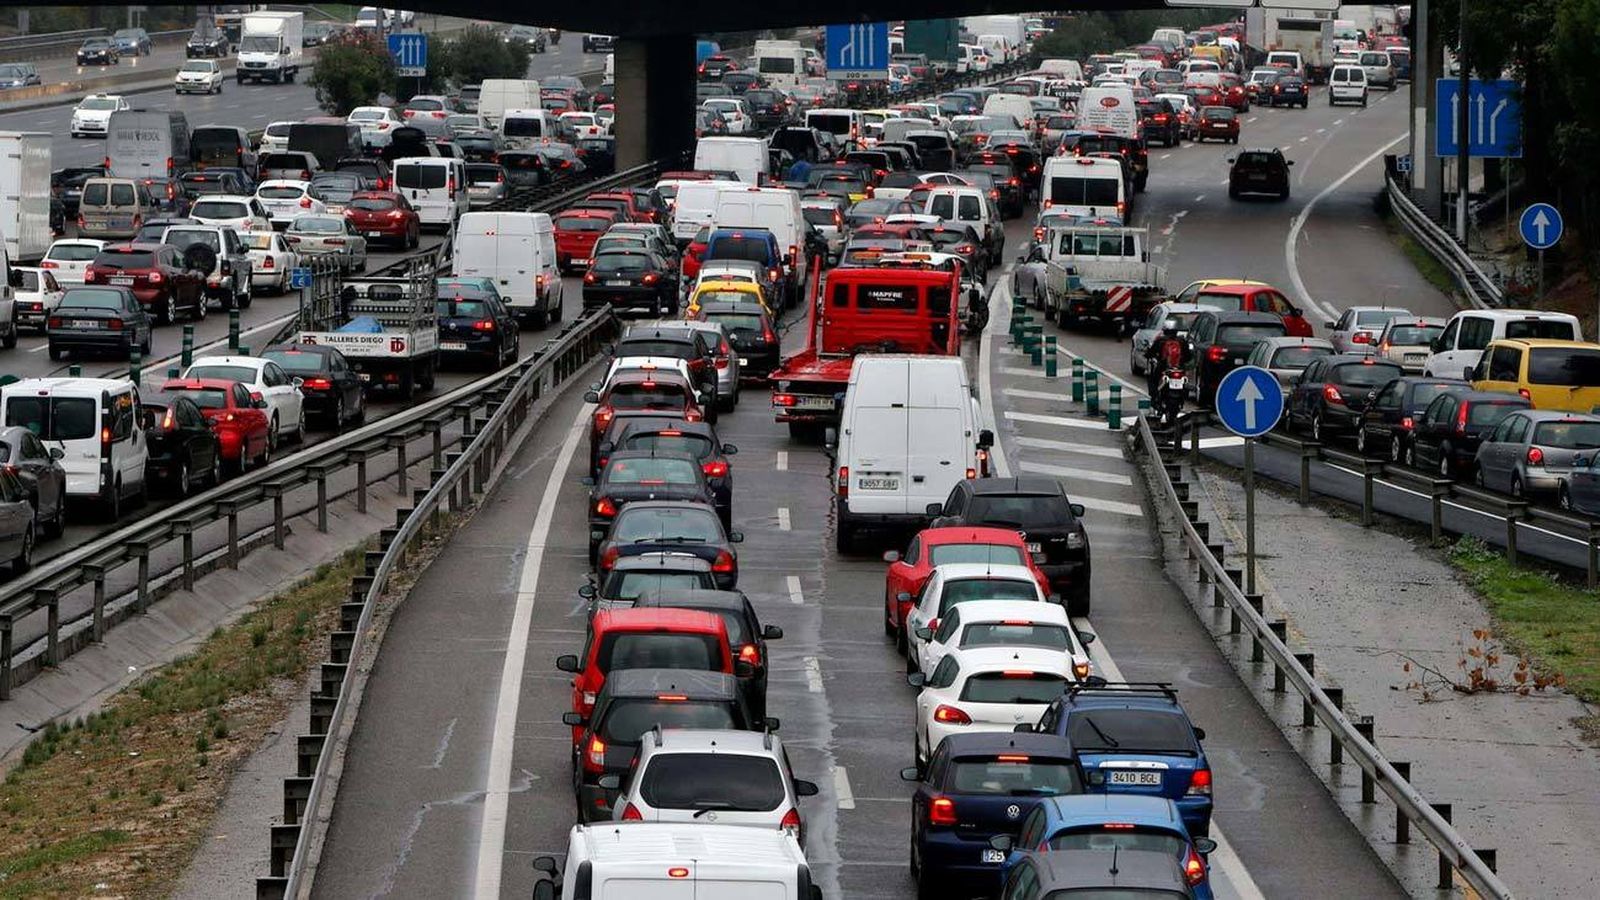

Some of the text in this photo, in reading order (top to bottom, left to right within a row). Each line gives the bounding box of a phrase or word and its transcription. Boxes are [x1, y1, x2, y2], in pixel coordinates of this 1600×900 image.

[872, 291, 903, 299] MAPFRE
[324, 335, 384, 344] TALLERES DIEGO
[1113, 772, 1158, 784] 3410 BGL
